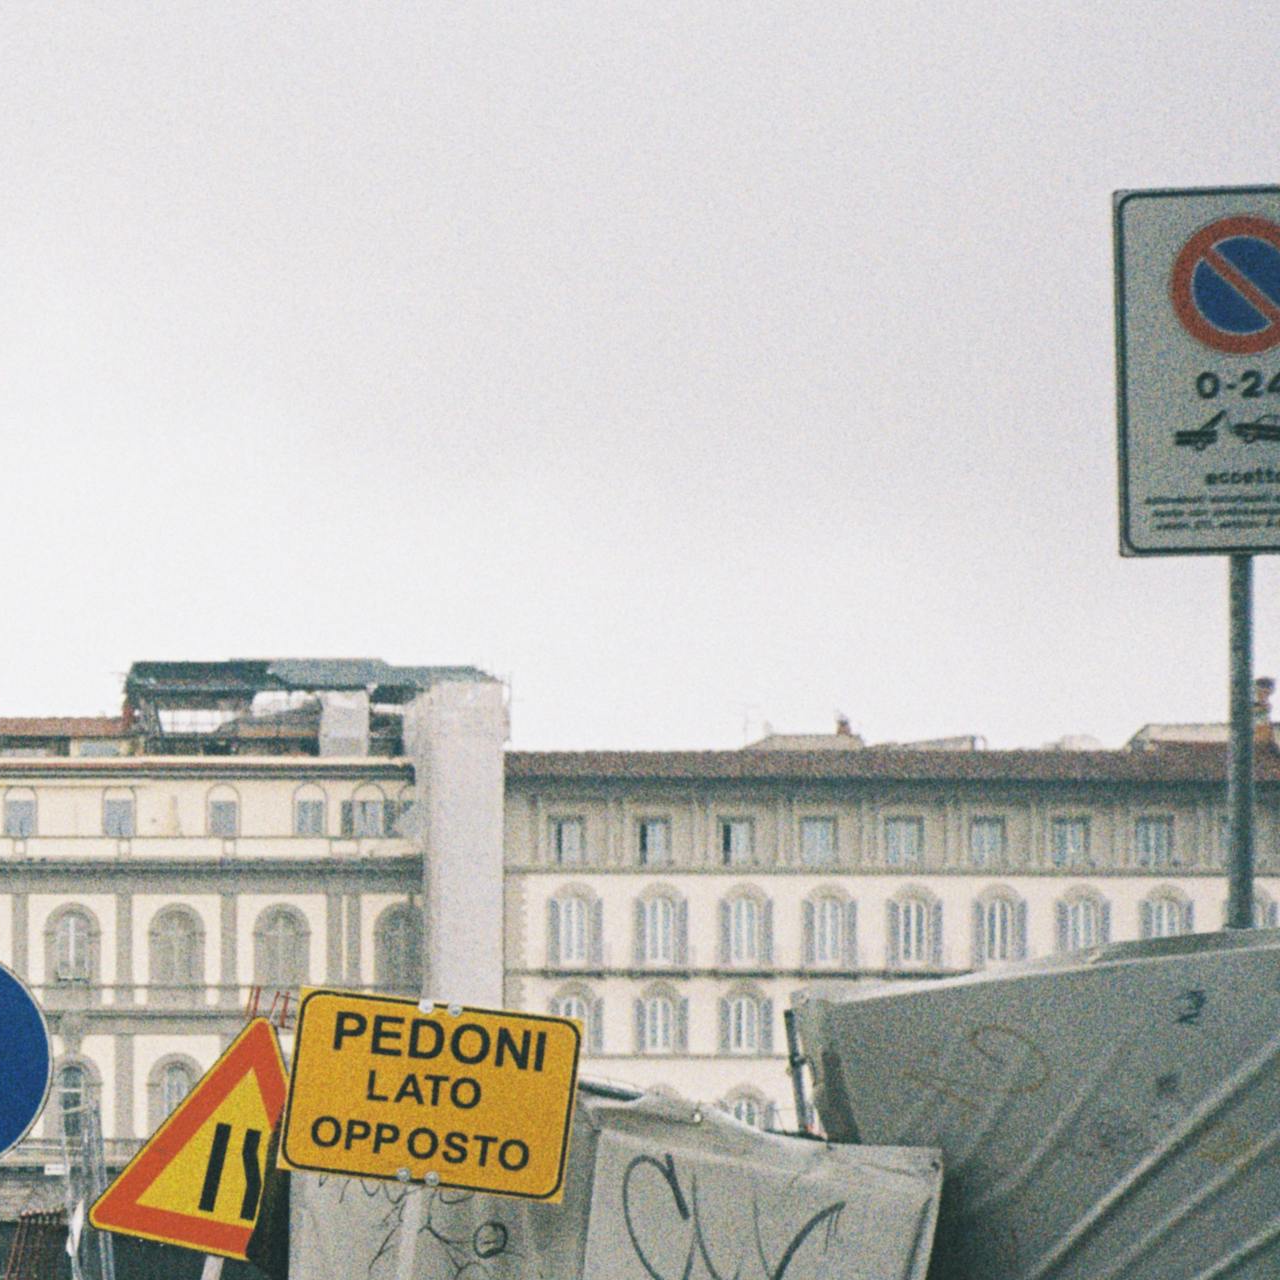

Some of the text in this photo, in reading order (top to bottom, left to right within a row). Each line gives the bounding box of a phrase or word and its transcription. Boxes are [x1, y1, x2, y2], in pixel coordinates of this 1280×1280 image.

[333, 1011, 547, 1072] PEDONI
[366, 1070, 482, 1109] LATO
[311, 1115, 530, 1172] OPPOSTO
